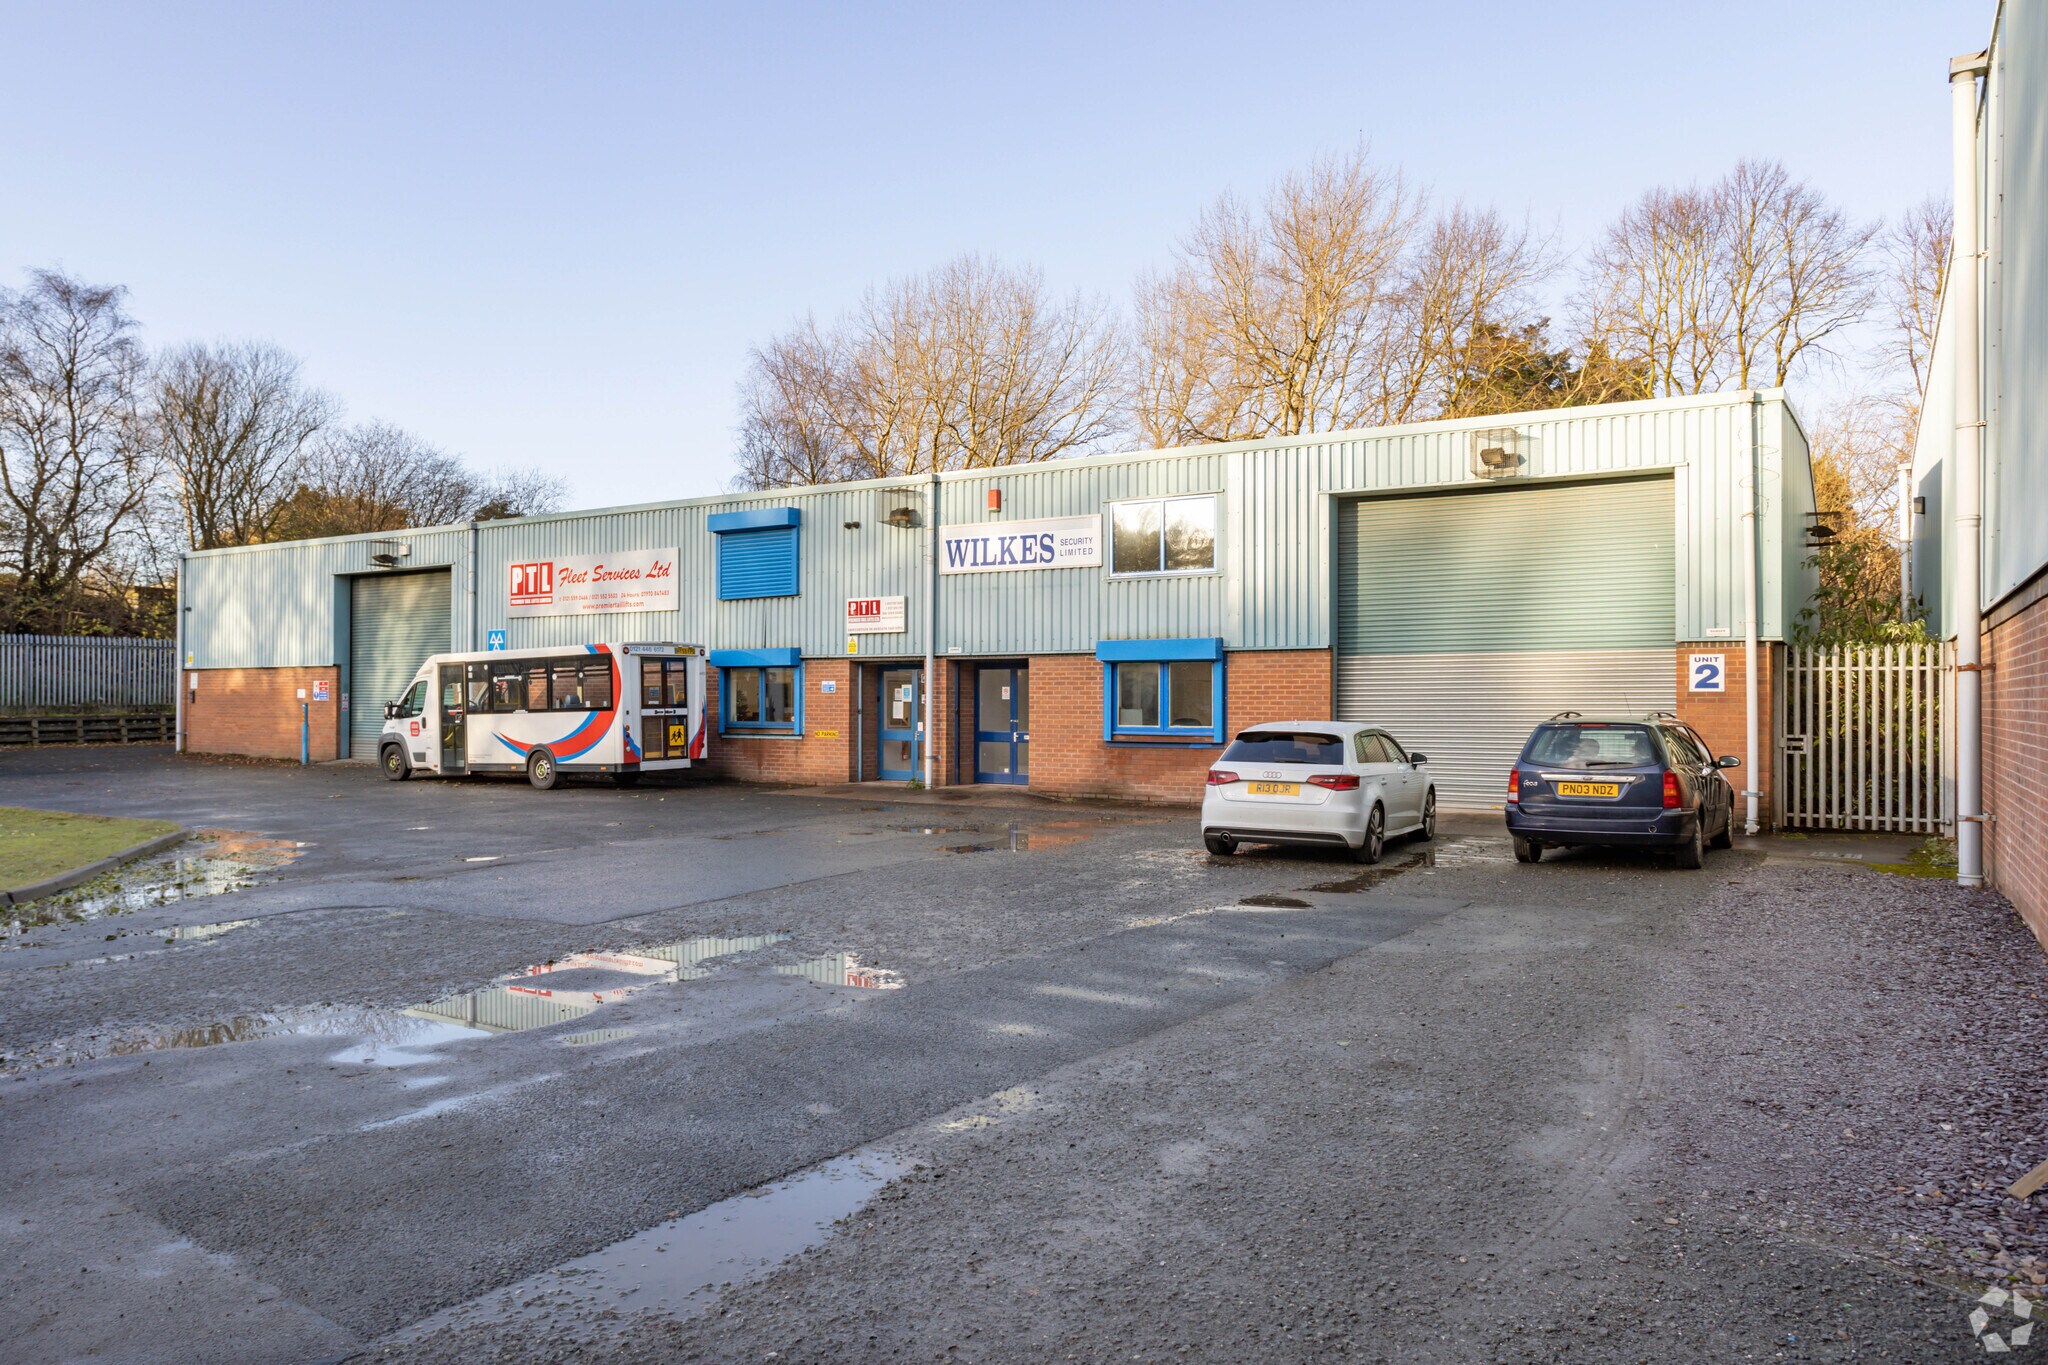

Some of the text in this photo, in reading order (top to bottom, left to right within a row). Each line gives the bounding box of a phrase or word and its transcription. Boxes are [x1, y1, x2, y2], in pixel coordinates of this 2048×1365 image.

[945, 533, 1055, 568] WILKES
[1060, 537, 1093, 546] SECURITY
[1060, 548, 1093, 556] LIMITED
[511, 564, 552, 595] PTL
[558, 560, 672, 588] Fleet Services Ltd
[850, 601, 878, 615] PTL
[1694, 663, 1720, 688] 2
[1562, 784, 1614, 795] PN03 NDZ
